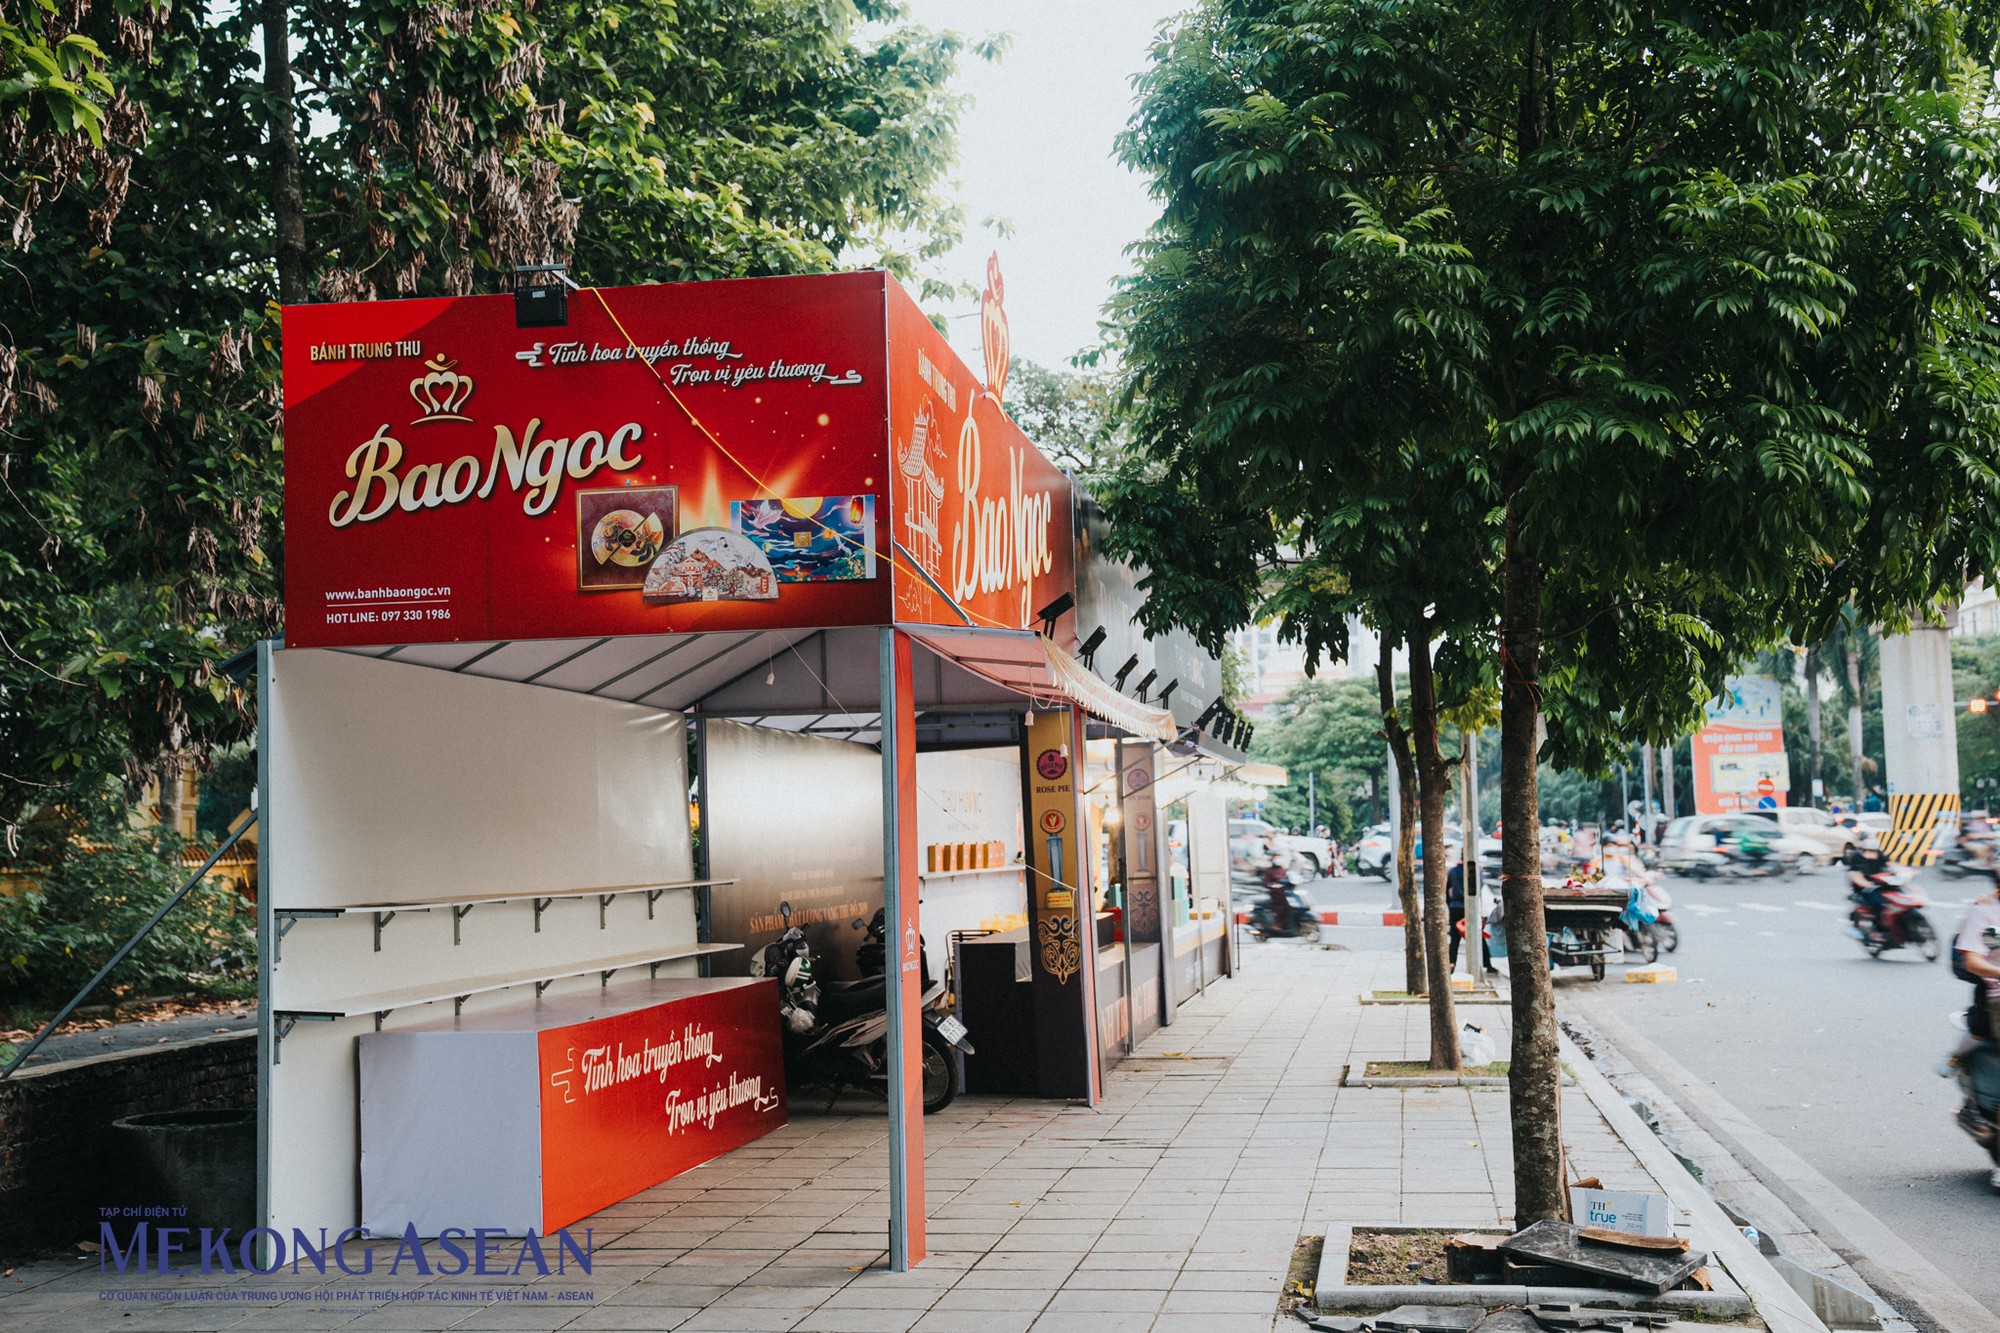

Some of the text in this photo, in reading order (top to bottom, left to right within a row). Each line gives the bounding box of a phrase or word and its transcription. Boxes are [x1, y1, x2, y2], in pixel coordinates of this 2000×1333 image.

[310, 340, 421, 360] BÁNH TRUNG THU
[549, 336, 743, 365] Tinh hoa truyền thống
[670, 359, 839, 387] Trọn vị yêu thương
[325, 587, 451, 600] www.banhbaongoc.vn
[326, 609, 451, 624] HOTLINE: 097 330 1986
[1036, 784, 1071, 794] ROSE PIE
[581, 1022, 722, 1095] Tinh hoa truyền thống
[665, 1071, 769, 1137] Trọn vị yêu thương
[1590, 1201, 1606, 1210] TH
[1590, 1209, 1617, 1223] true
